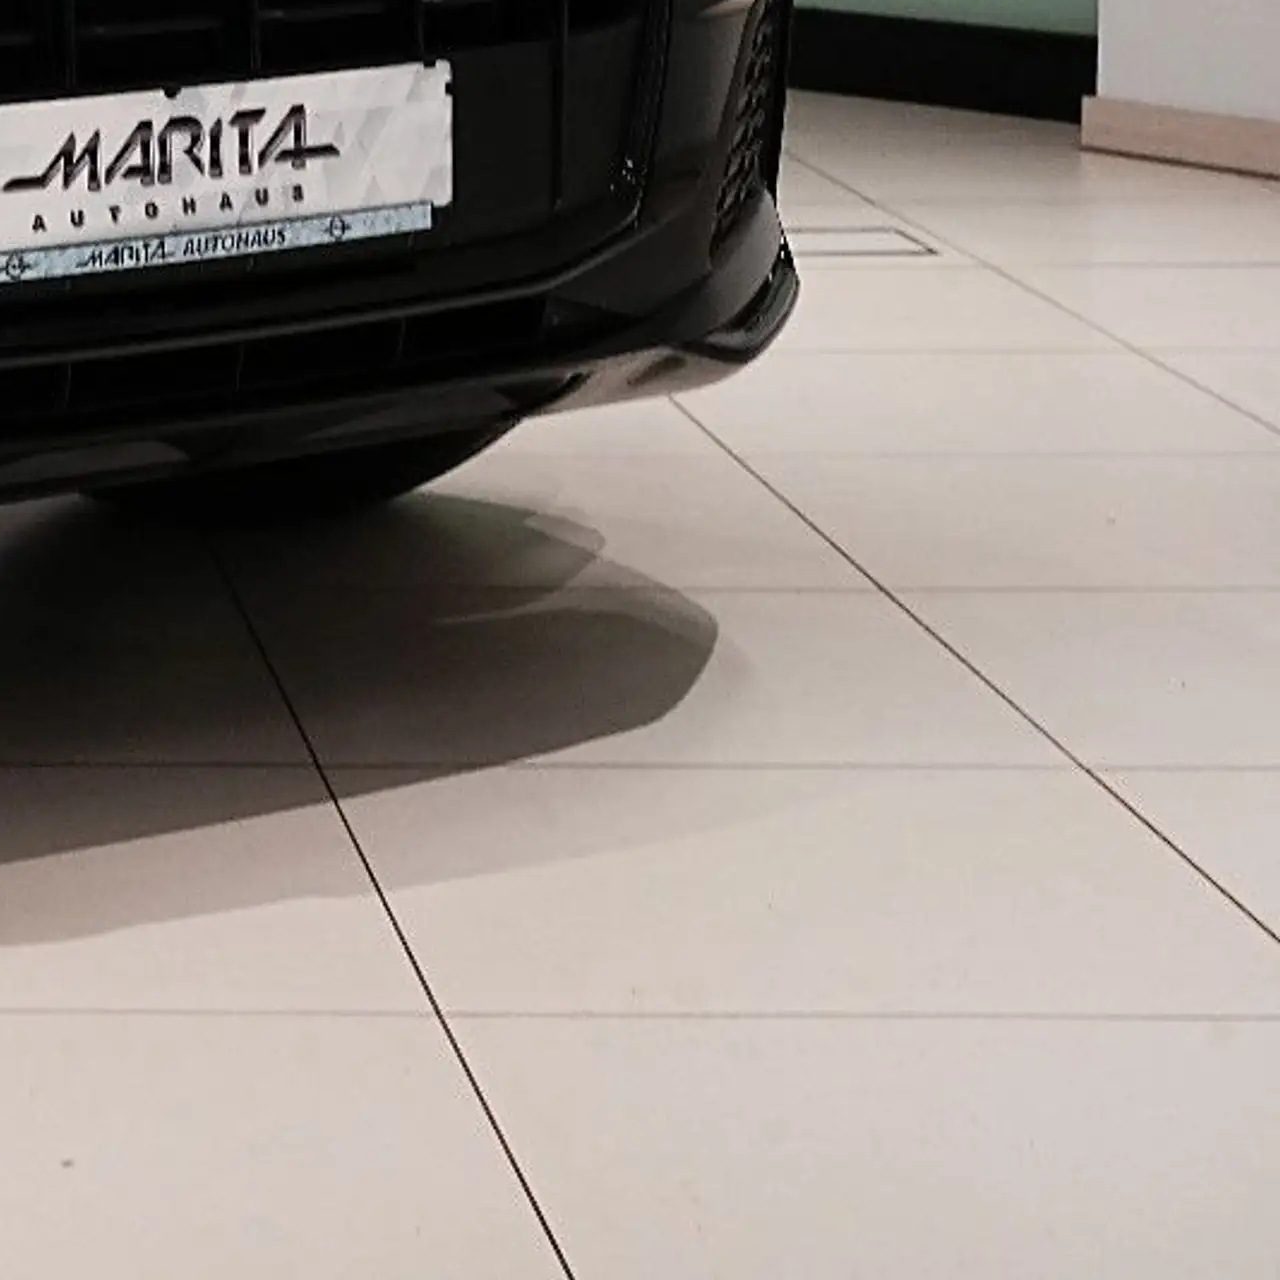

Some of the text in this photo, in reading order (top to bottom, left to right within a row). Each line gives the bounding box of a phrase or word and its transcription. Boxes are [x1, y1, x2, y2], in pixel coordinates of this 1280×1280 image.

[2, 104, 341, 192] MARITA
[32, 183, 304, 231] AUTOHAUS
[76, 228, 287, 269] MARITA AUTOHAUS
